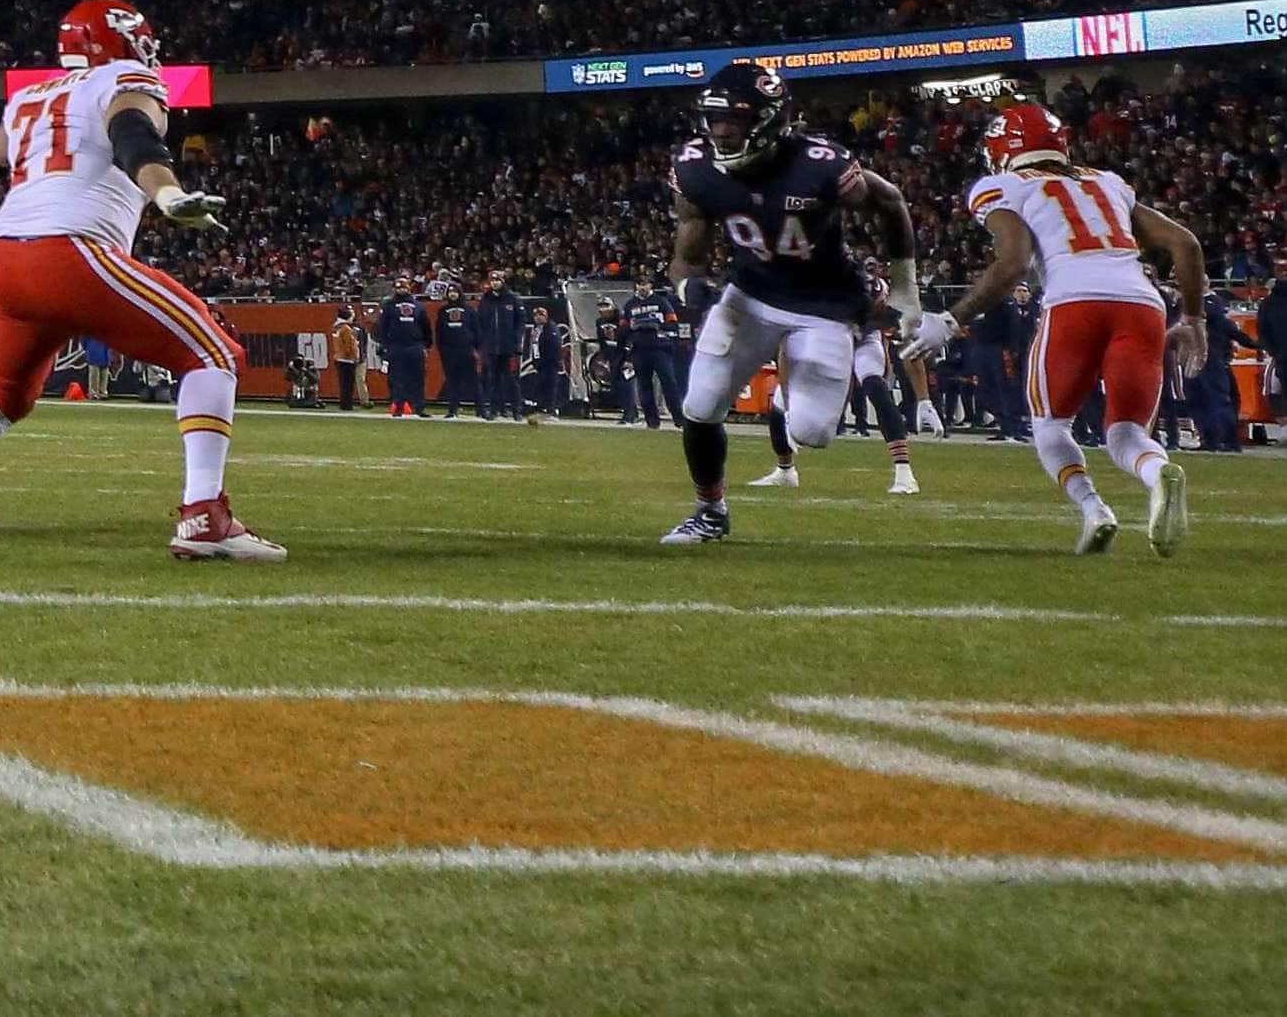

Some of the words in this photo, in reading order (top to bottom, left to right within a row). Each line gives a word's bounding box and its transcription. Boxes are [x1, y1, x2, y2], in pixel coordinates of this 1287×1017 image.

[1080, 12, 1146, 56] NFL
[1245, 9, 1287, 39] Reg
[587, 63, 608, 71] NEXT
[609, 62, 626, 71] GEN
[755, 56, 782, 69] NEXT
[786, 54, 805, 67] GEN
[807, 52, 835, 66] STATS
[836, 48, 881, 64] POWERED
[884, 47, 896, 60] BY
[898, 43, 939, 59] AMAZON
[942, 41, 964, 55] WEB
[966, 37, 1012, 52] SERVICES
[586, 70, 626, 84] STATS
[643, 64, 674, 77] powered
[675, 63, 684, 76] by
[12, 92, 73, 188] 71
[1043, 179, 1138, 254] 11
[727, 215, 816, 262] 94
[177, 513, 211, 540] NIKE
